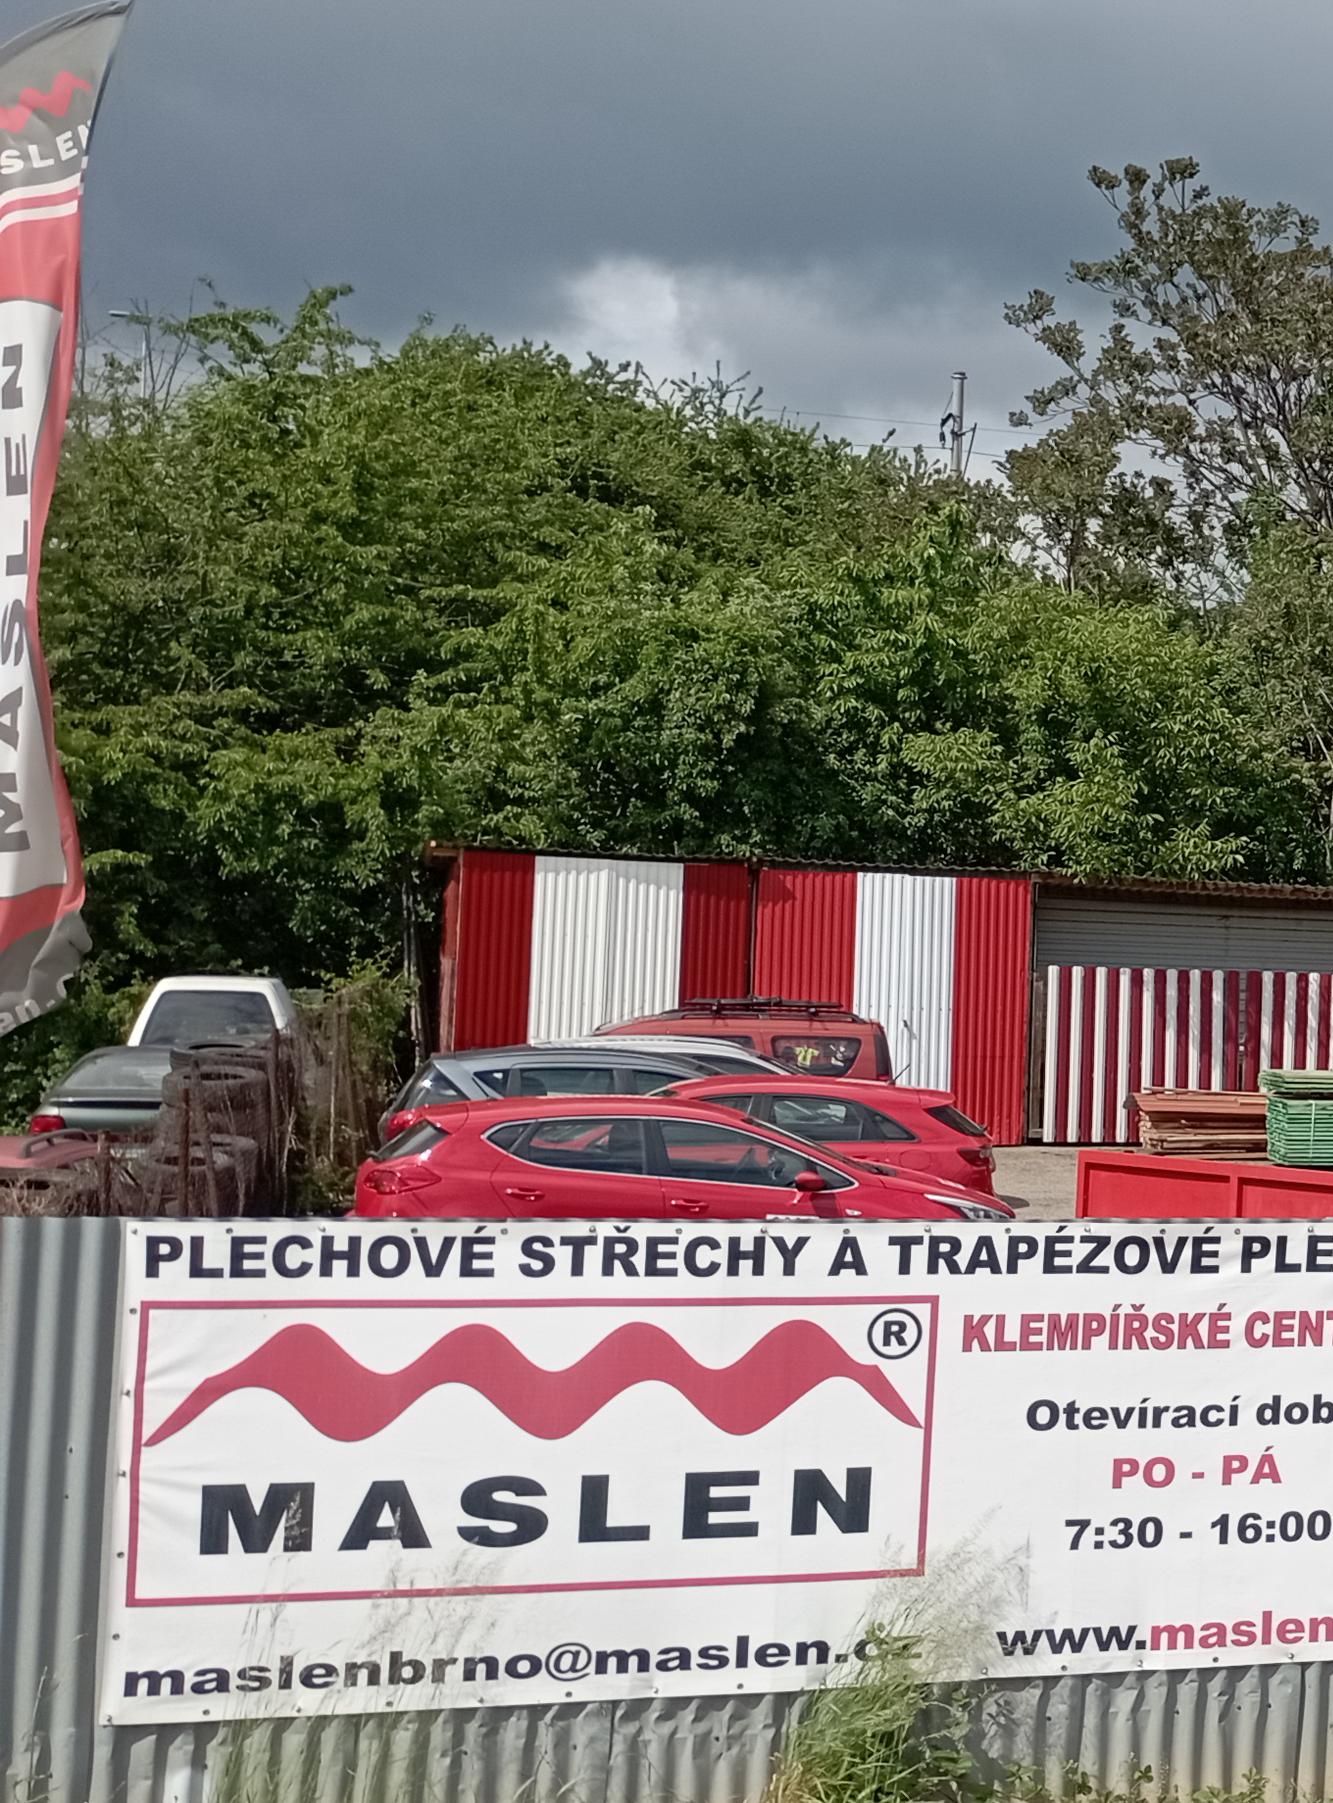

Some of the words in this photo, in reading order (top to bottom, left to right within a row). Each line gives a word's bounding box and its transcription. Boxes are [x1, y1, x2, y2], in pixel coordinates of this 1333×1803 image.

[145, 1225, 496, 1279] PLECHOVÉ
[518, 1225, 811, 1278] STŘECHY
[827, 1235, 869, 1277] A
[888, 1226, 1222, 1275] TRAPÉZOVÉ
[961, 1302, 1232, 1353] KLEMPÍŘSKÉ
[1026, 1396, 1242, 1432] Otevírací
[1112, 1456, 1176, 1490] PO
[1221, 1445, 1283, 1486] PÁ
[199, 1466, 873, 1556] MASLEN
[1064, 1516, 1164, 1551] 7:30
[1210, 1509, 1332, 1545] 16:00
